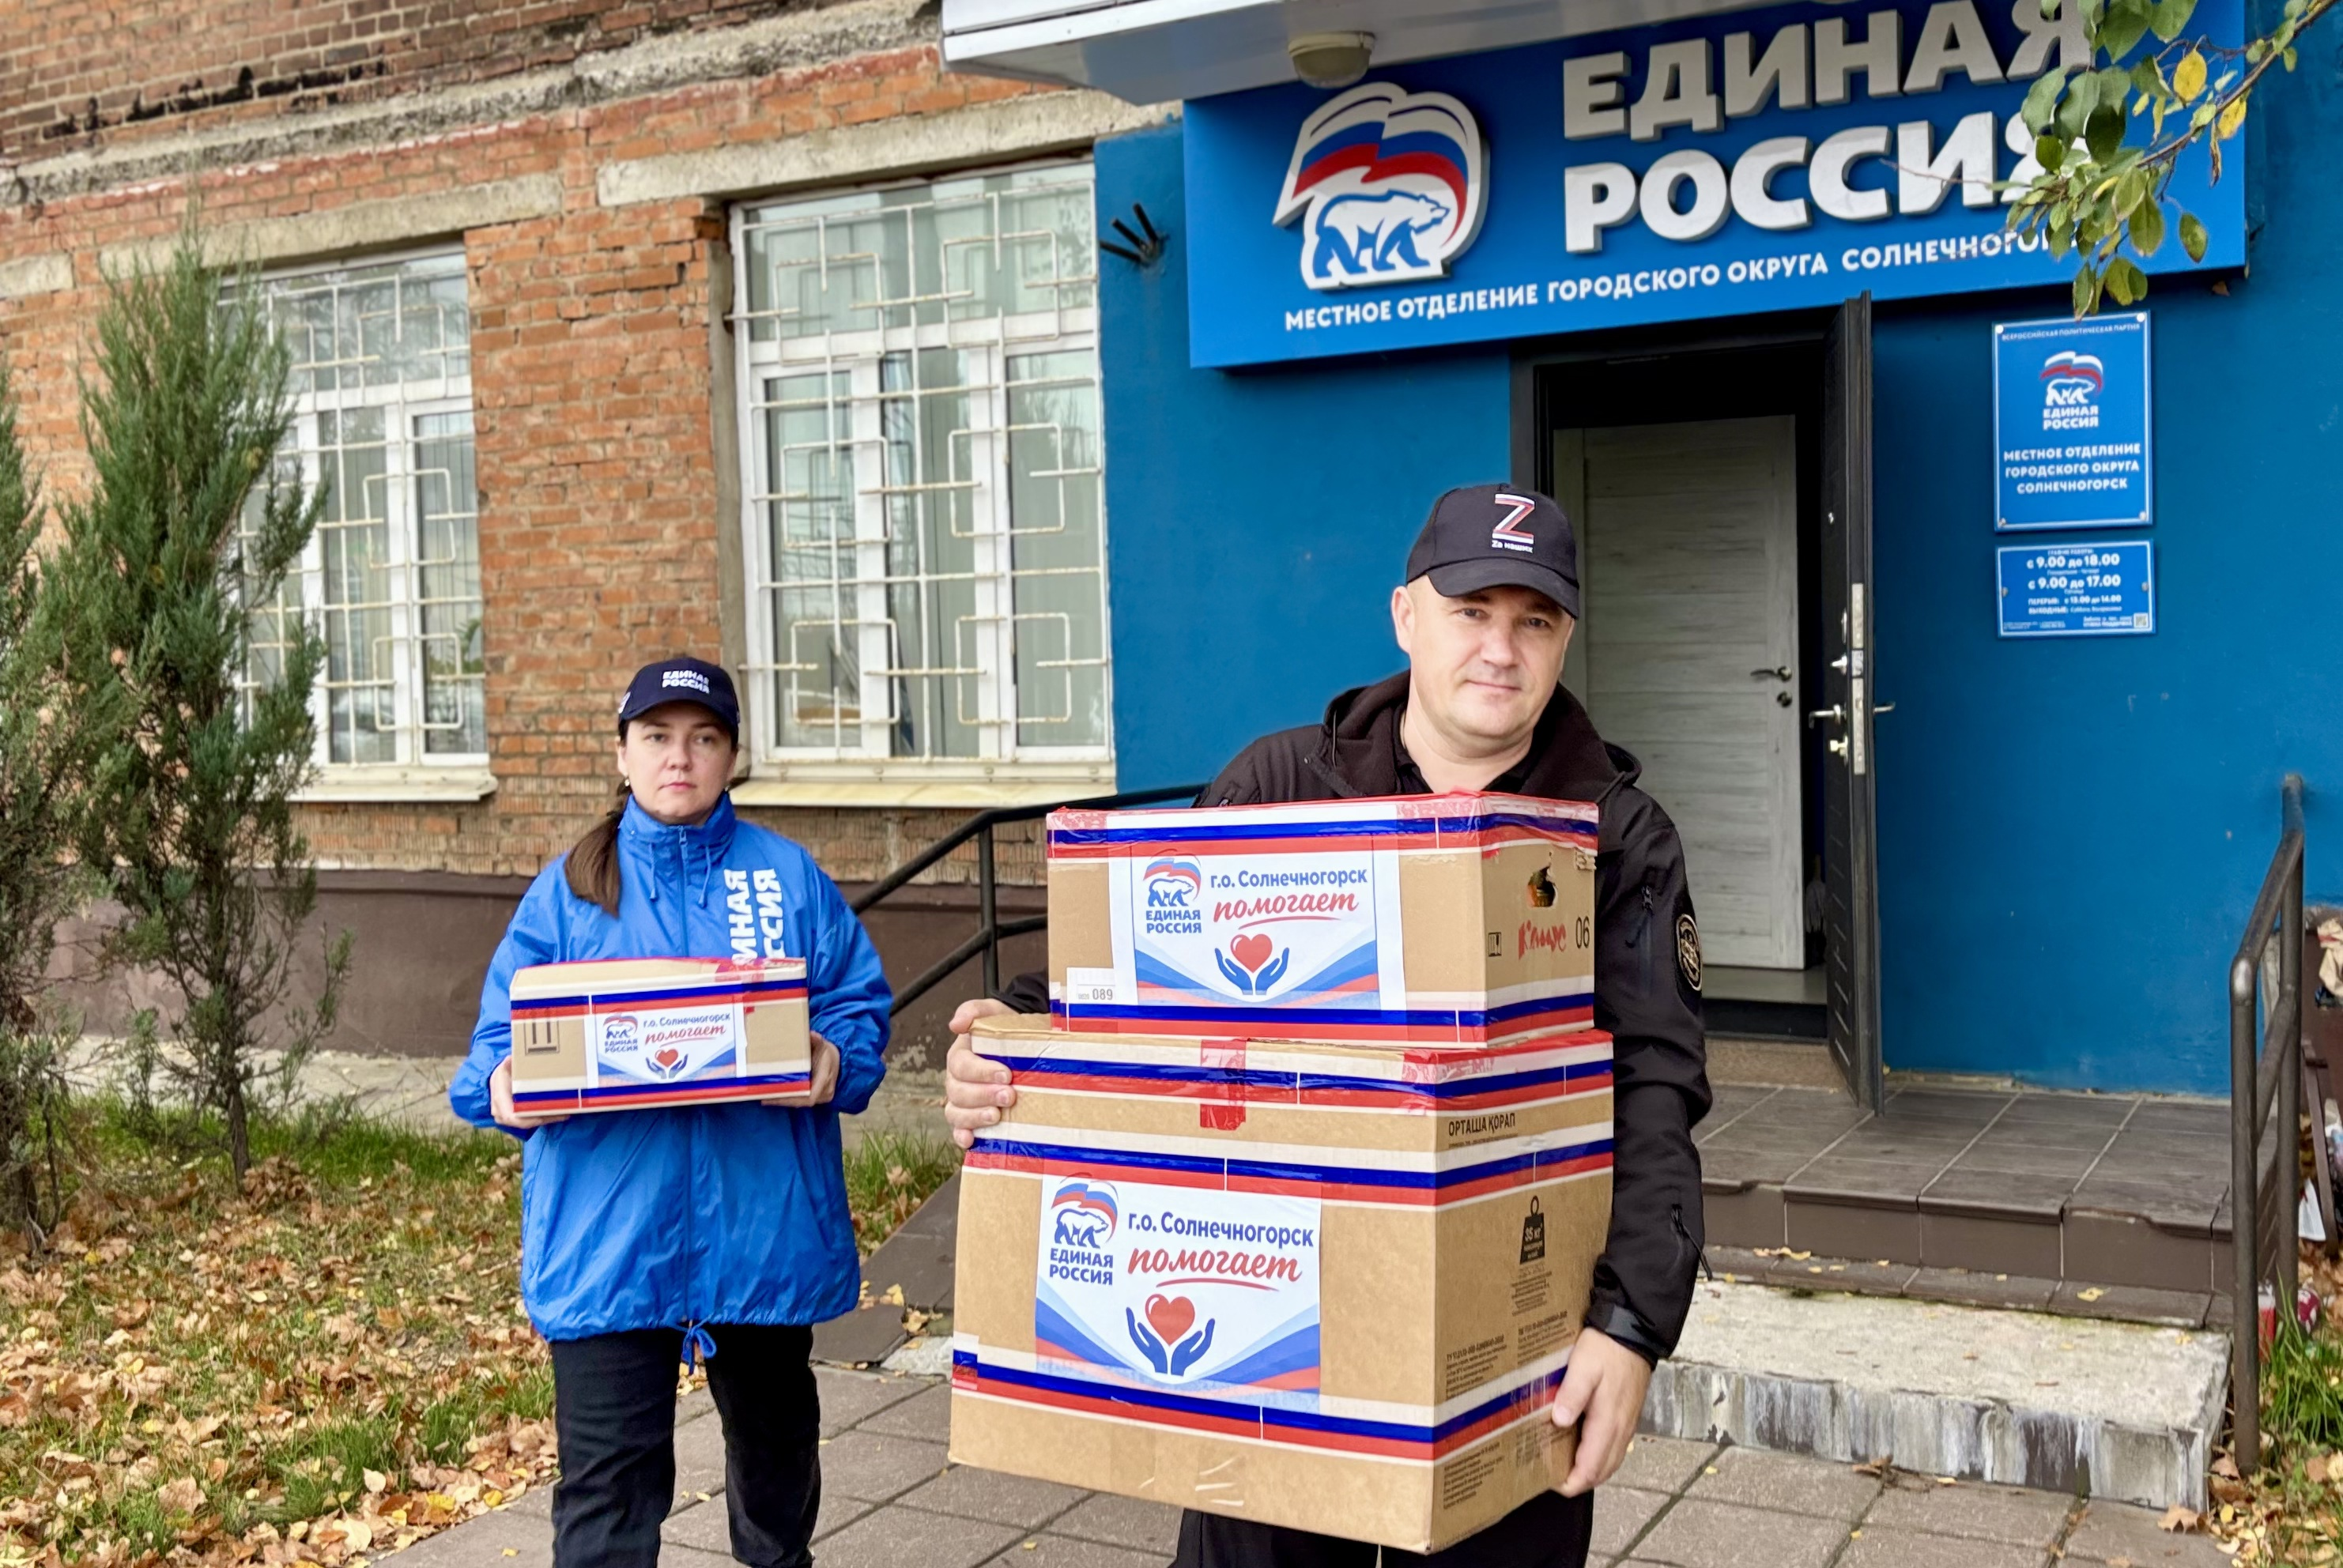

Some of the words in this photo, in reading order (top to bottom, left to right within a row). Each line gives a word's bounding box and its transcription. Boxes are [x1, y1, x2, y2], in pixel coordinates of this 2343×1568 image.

[1564, 0, 2096, 141] ЕДИНАЯ
[1285, 301, 1391, 331] МЕСТНОЕ
[1398, 283, 1538, 320] ОТДЕЛЕНИЕ
[1547, 265, 1721, 303] ГОРОДСКОГО
[1727, 252, 1828, 285] ОКРУГА
[1842, 228, 2100, 267] СОЛНЕЧНОГО
[2058, 325, 2113, 337] ПОЛИТИЧЕСКАЯ
[2114, 322, 2141, 332] ПАРТИЯ
[2043, 405, 2099, 419] ЕДИНАЯ
[2043, 416, 2099, 430] РОССИЯ
[2003, 449, 2062, 462] МЕСТНОЕ
[2065, 443, 2141, 458] ОТДЕЛЕНИЕ
[2005, 462, 2089, 479] ГОРОДСКОГО
[2092, 460, 2140, 474] ОКРУГА
[2017, 477, 2128, 495] СОЛНЕЧНОГОРСК
[1492, 494, 1535, 544] Z
[2036, 556, 2066, 569] 9.00
[2068, 557, 2083, 568] до
[2084, 553, 2120, 567] 18.00
[2038, 577, 2067, 590] 9.00
[2069, 579, 2085, 590] до
[2086, 574, 2121, 587] 17.00
[662, 670, 710, 685] ЕДИНАЯ
[662, 678, 710, 695] РОССИЯ
[1210, 873, 1236, 889] г.о.
[1238, 868, 1368, 891] Солнечногорск
[723, 869, 758, 965] ИНАЯ
[753, 868, 786, 958] ССИЯ
[1145, 910, 1202, 923] ЕДИНАЯ
[1213, 892, 1360, 923] помогает
[1146, 922, 1202, 935] РОССИЯ
[1092, 988, 1113, 1001] 089
[659, 1012, 731, 1027] Солнечногорск
[644, 1024, 726, 1046] помогает
[1448, 1119, 1487, 1136] ОРТАША
[1488, 1113, 1516, 1133] ҚОРАП
[1128, 1212, 1157, 1232] г.о.
[1160, 1211, 1314, 1249] Солнечногорск
[1050, 1248, 1114, 1268] ЕДИНАЯ
[1127, 1246, 1302, 1283] помогает
[1049, 1265, 1114, 1286] РОССИЯ
